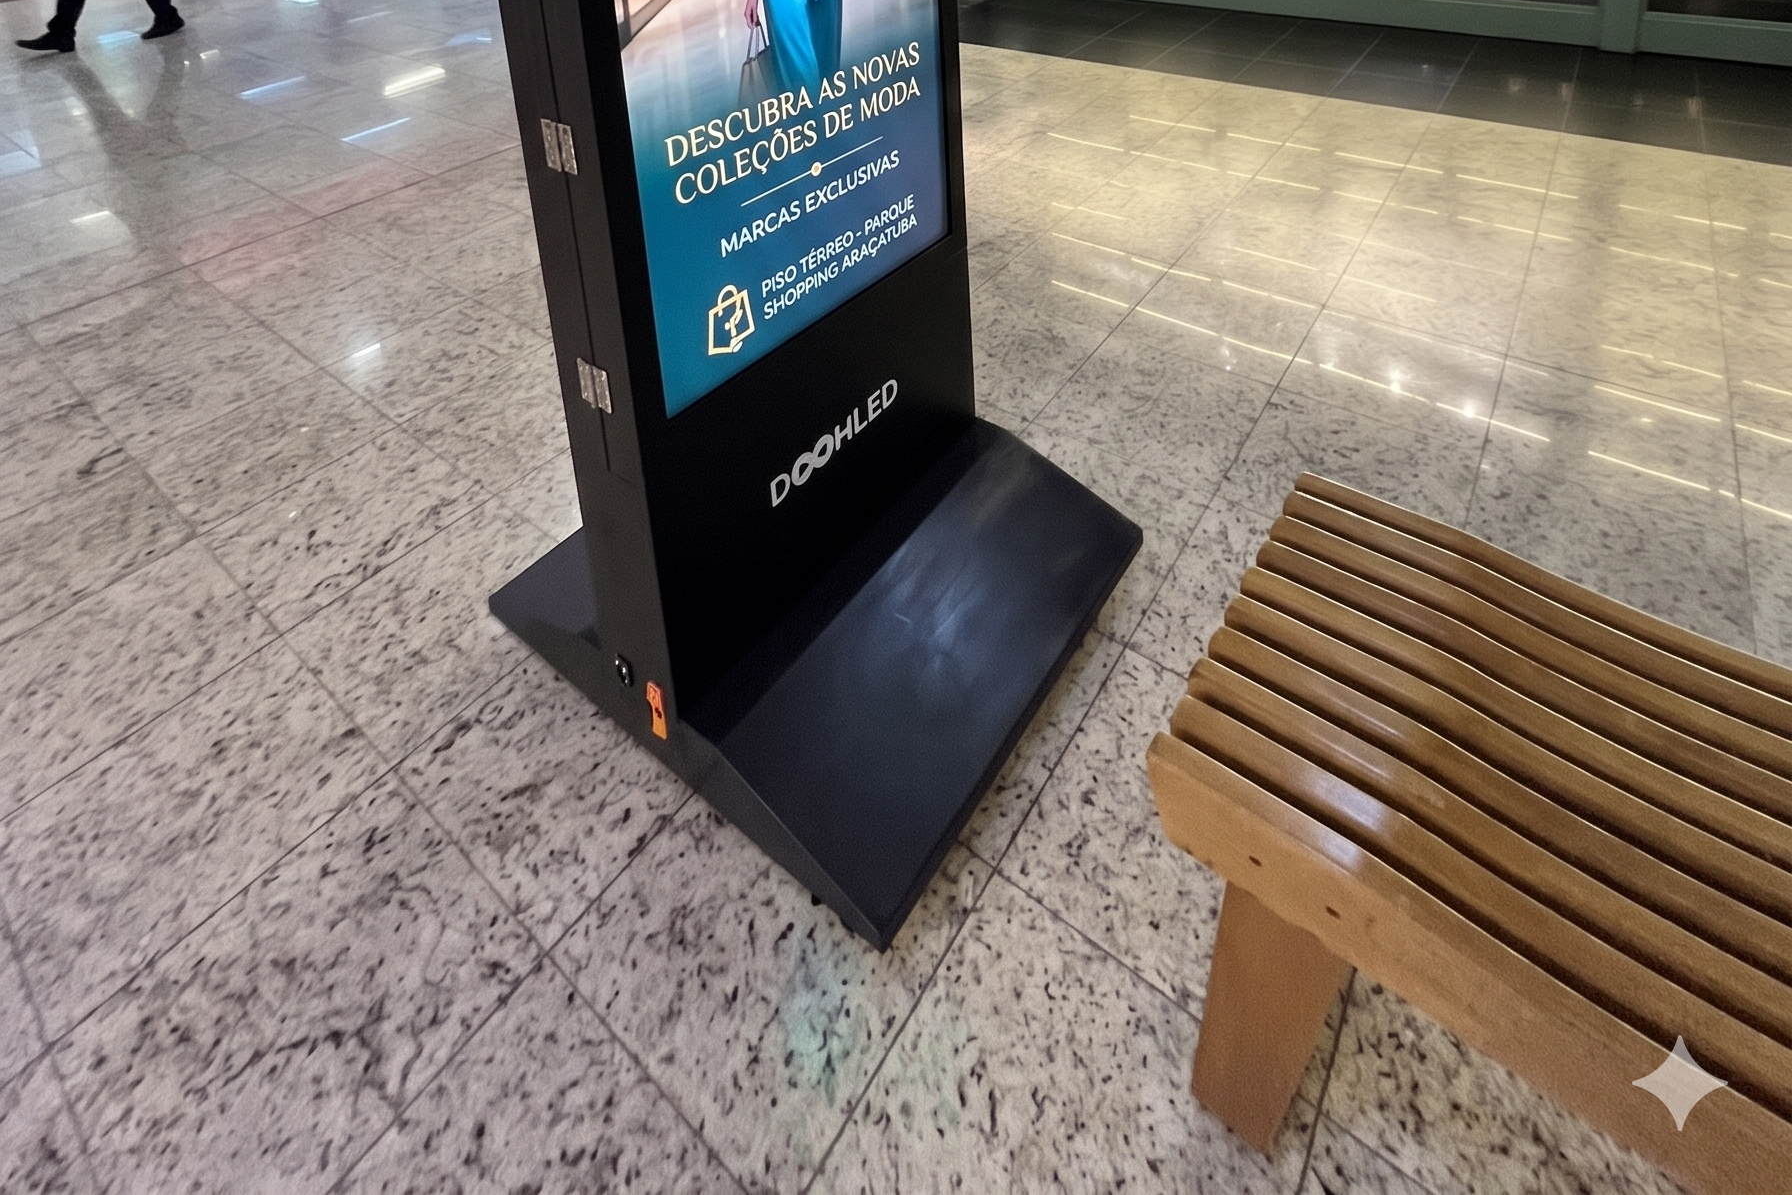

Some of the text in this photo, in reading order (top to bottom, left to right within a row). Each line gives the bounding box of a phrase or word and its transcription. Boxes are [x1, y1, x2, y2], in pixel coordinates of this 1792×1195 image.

[664, 41, 920, 167] DESCUBRA AS NOVAS
[675, 76, 921, 205] COLEÇÕES DE MODA
[720, 149, 900, 258] MARCAS EXCLUSIVAS
[761, 265, 797, 298] PISO
[800, 230, 854, 274] TÉRREO
[864, 194, 915, 236] PARQUE
[763, 213, 918, 320] SHOPPING ARAÇATUBA
[770, 378, 898, 508] DOOHLED
